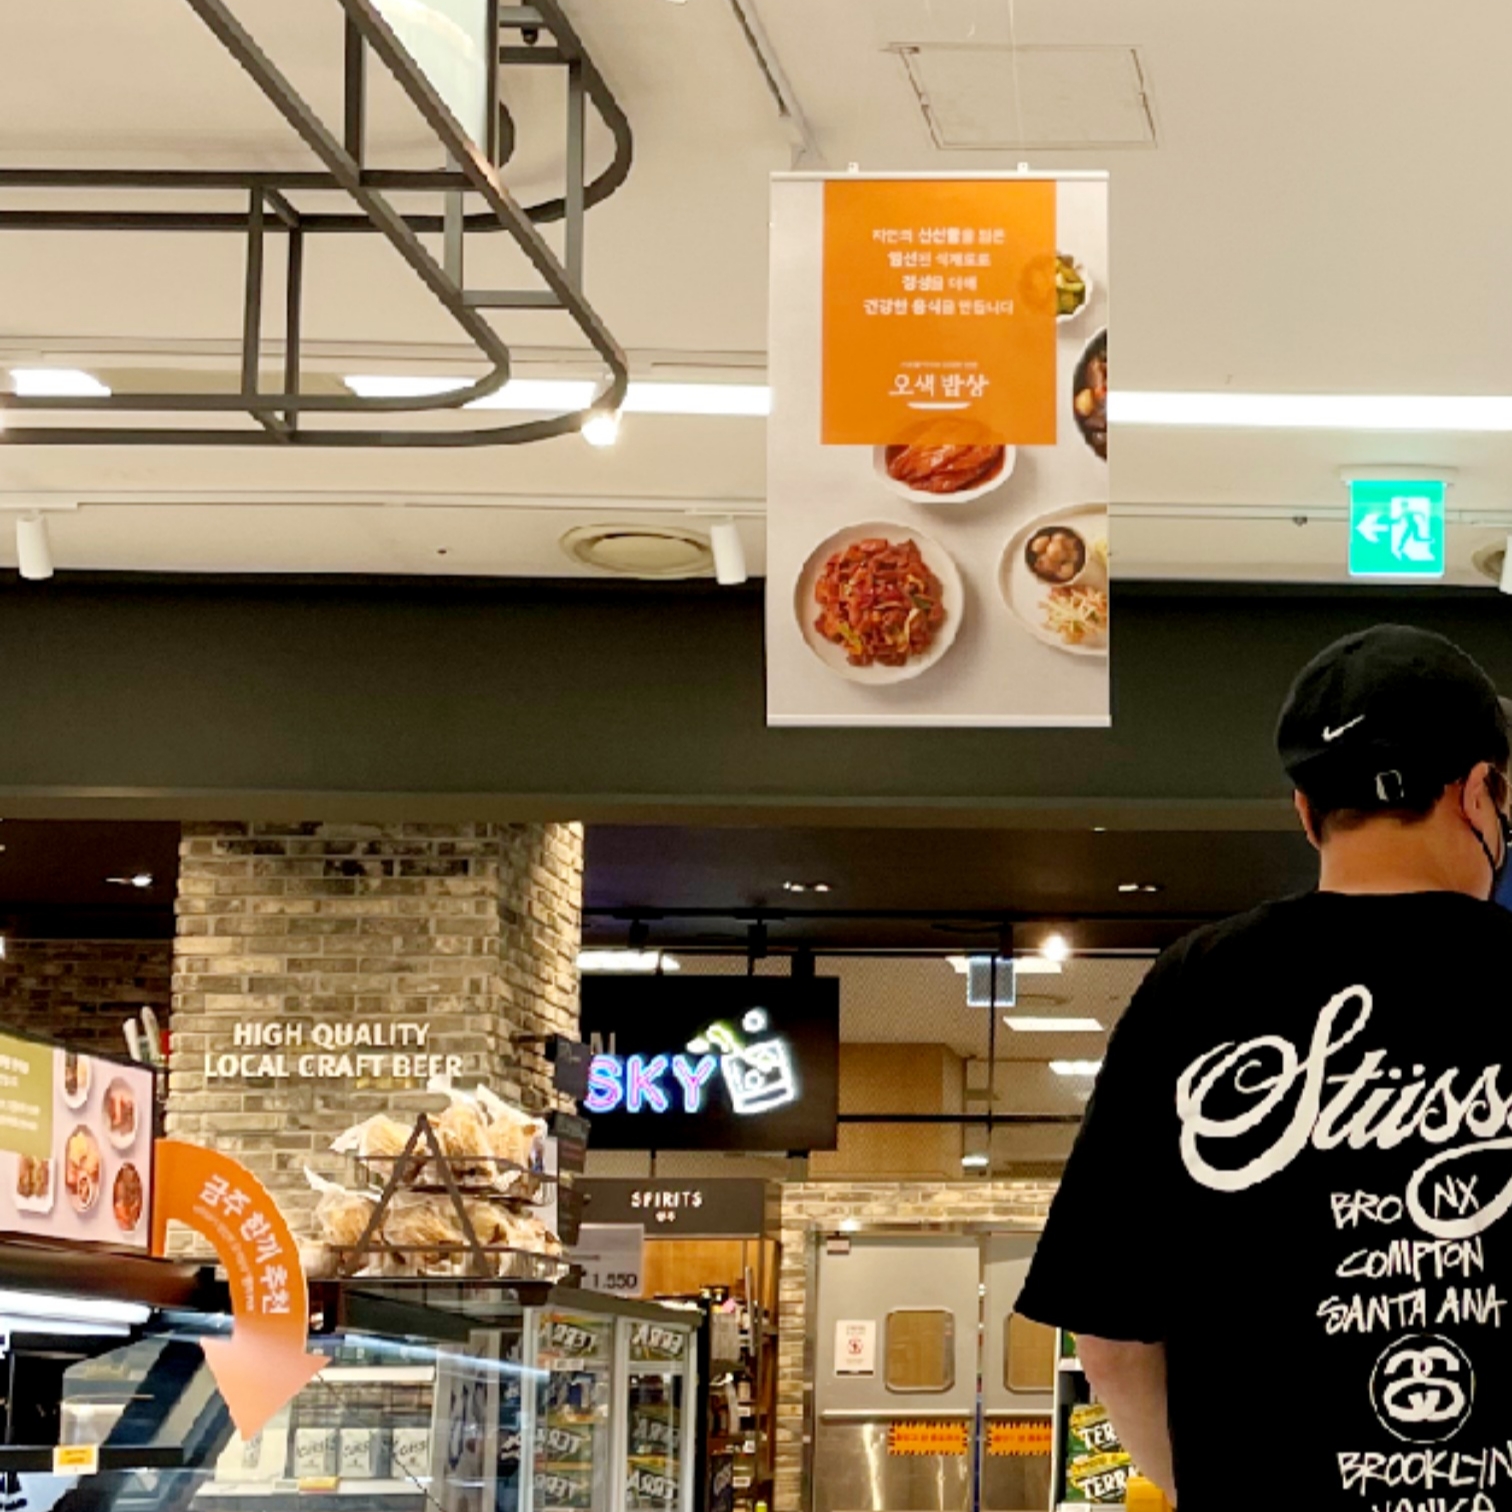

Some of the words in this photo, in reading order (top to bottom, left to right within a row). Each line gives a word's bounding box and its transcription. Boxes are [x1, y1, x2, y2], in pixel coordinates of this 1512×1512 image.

[233, 1023, 302, 1046] HIGH
[311, 1023, 430, 1050] QUALITY
[204, 1054, 290, 1077] LOCAL
[298, 1054, 384, 1077] CRAFT
[392, 1054, 463, 1078] BEER
[584, 1054, 717, 1113] SKY
[631, 1191, 703, 1208] SPIRITS
[1336, 1236, 1483, 1283] COMPTON
[260, 1264, 290, 1314] 추천
[1316, 1288, 1427, 1335] SANTA
[1435, 1284, 1507, 1327] ANA
[1079, 1421, 1119, 1450] TER
